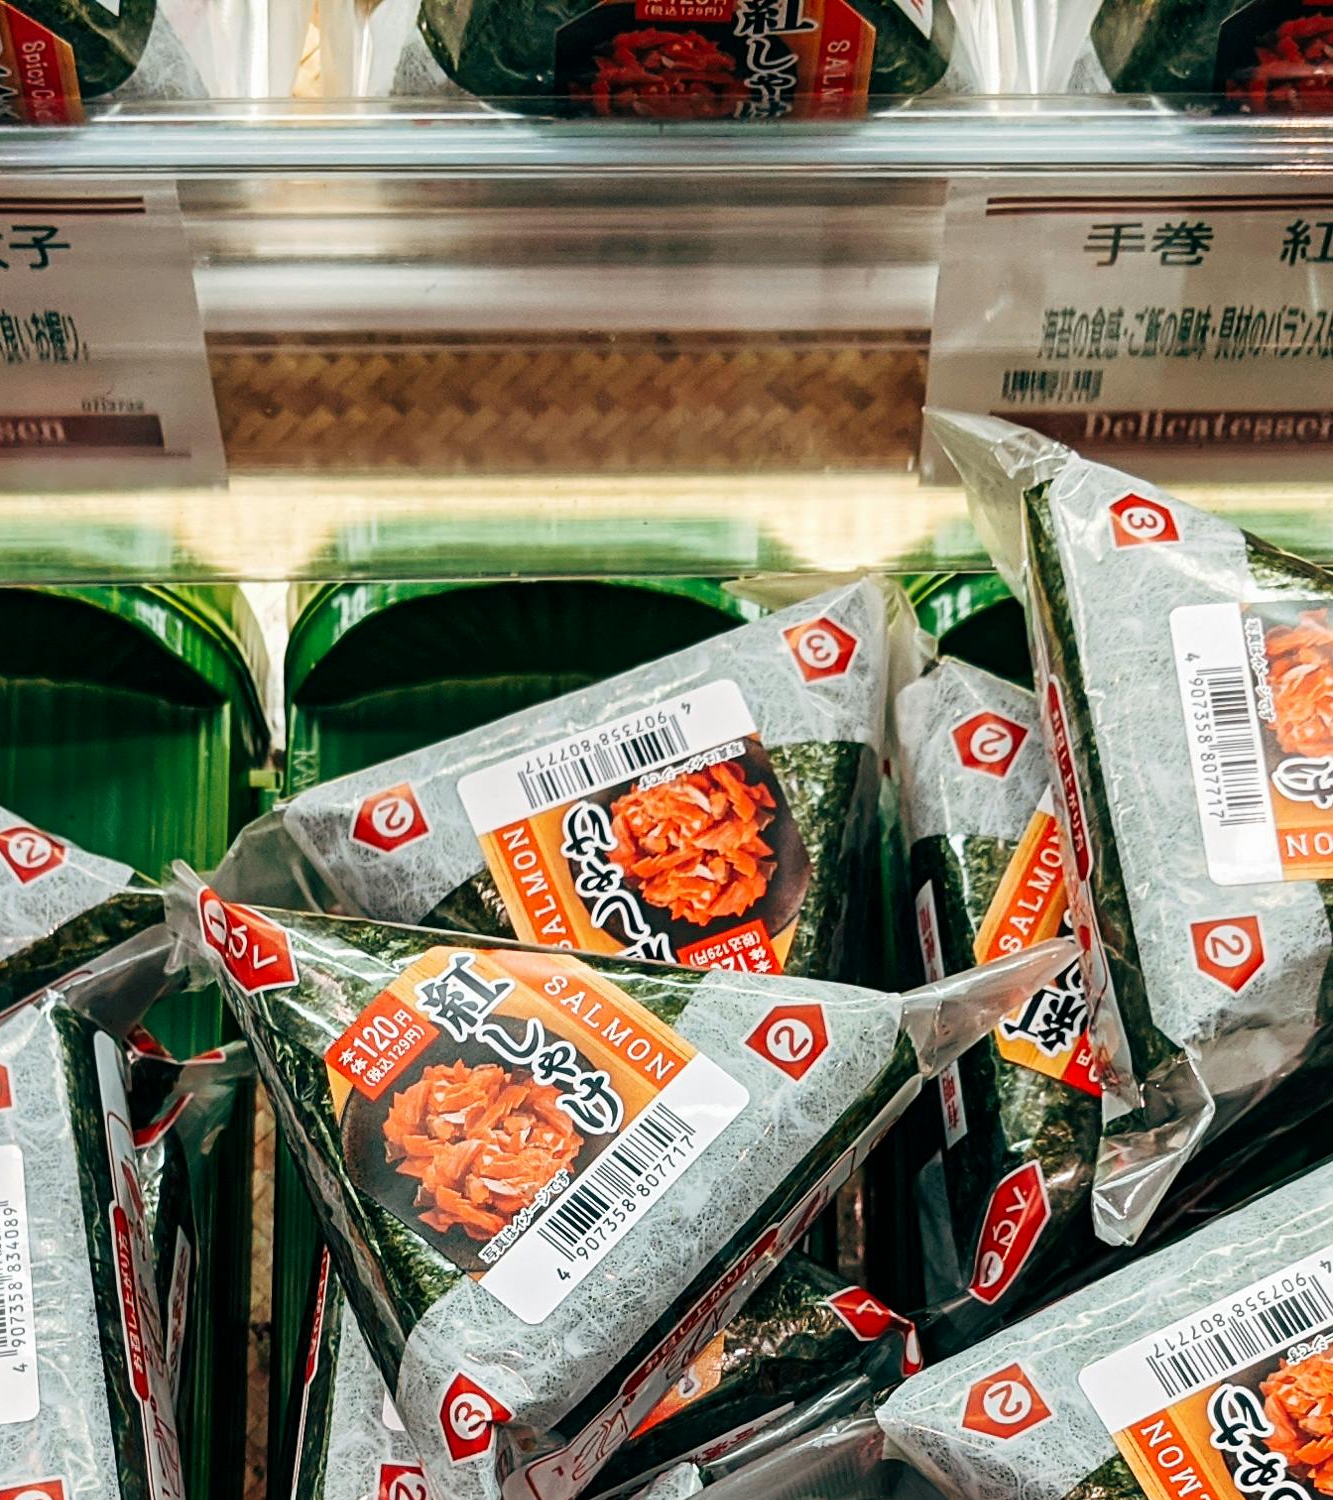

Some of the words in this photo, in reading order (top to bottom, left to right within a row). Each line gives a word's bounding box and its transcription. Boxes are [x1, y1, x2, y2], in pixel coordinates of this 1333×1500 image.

[21, 39, 47, 89] Spicy
[1083, 221, 1215, 268] 手巻
[360, 1023, 428, 1089] (税込129円)
[415, 955, 626, 1131] 紅しゃけ
[539, 973, 676, 1082] SALMON
